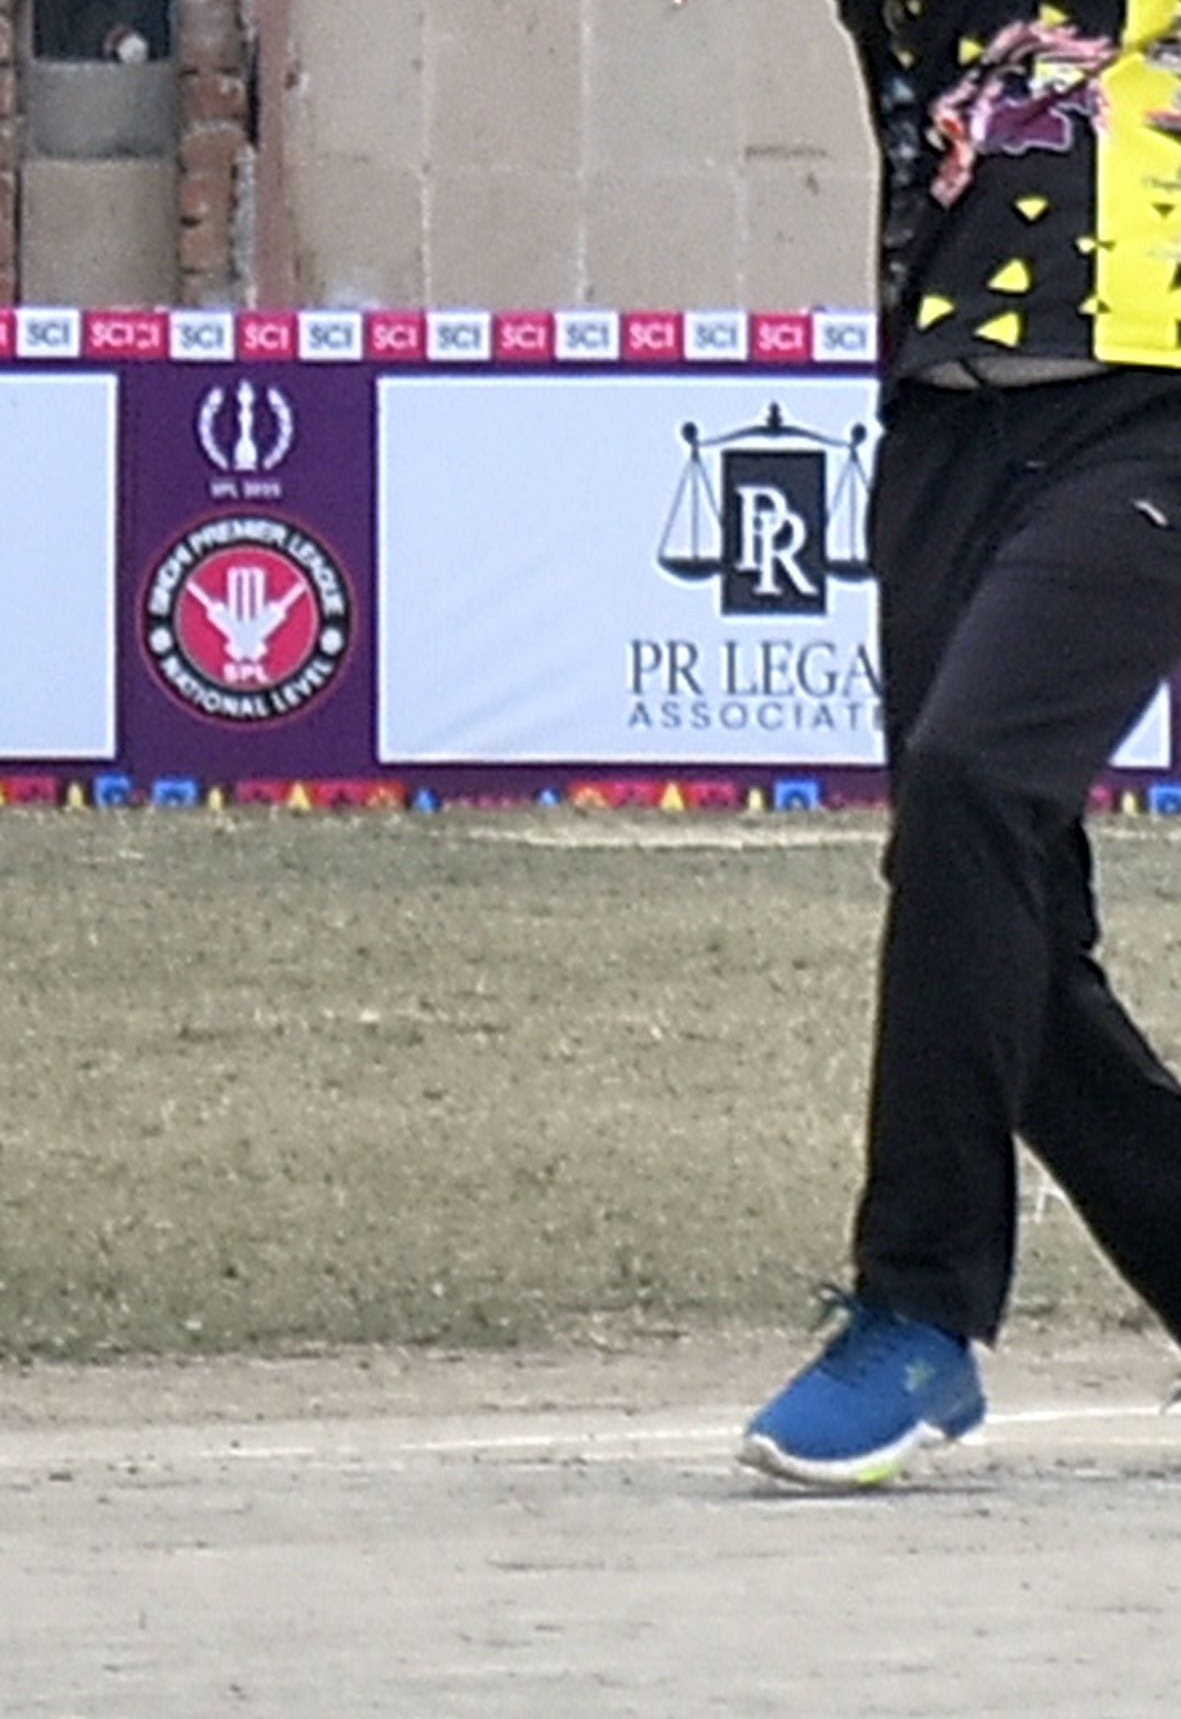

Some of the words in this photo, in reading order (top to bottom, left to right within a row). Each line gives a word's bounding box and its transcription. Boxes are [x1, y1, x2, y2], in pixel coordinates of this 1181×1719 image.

[27, 322, 69, 346] SCI
[92, 322, 133, 347] SCI
[181, 323, 223, 349] SCI
[244, 324, 289, 349] SCI
[309, 324, 351, 348] SCI
[374, 323, 417, 348] SCI
[437, 324, 480, 349] SCI
[501, 323, 545, 348] SCI
[566, 324, 608, 349] SCI
[629, 323, 674, 349] SCI
[697, 324, 742, 349] SCI
[758, 323, 802, 349] SCI
[822, 324, 866, 350] SCI
[187, 519, 288, 557] PREMIER
[287, 534, 345, 616] LEAGUE
[160, 655, 268, 717] NATIONAL
[269, 660, 334, 713] LEVEL
[630, 640, 703, 695] PR
[724, 640, 883, 697] LEGA
[629, 701, 884, 730] ASSOCIAT
